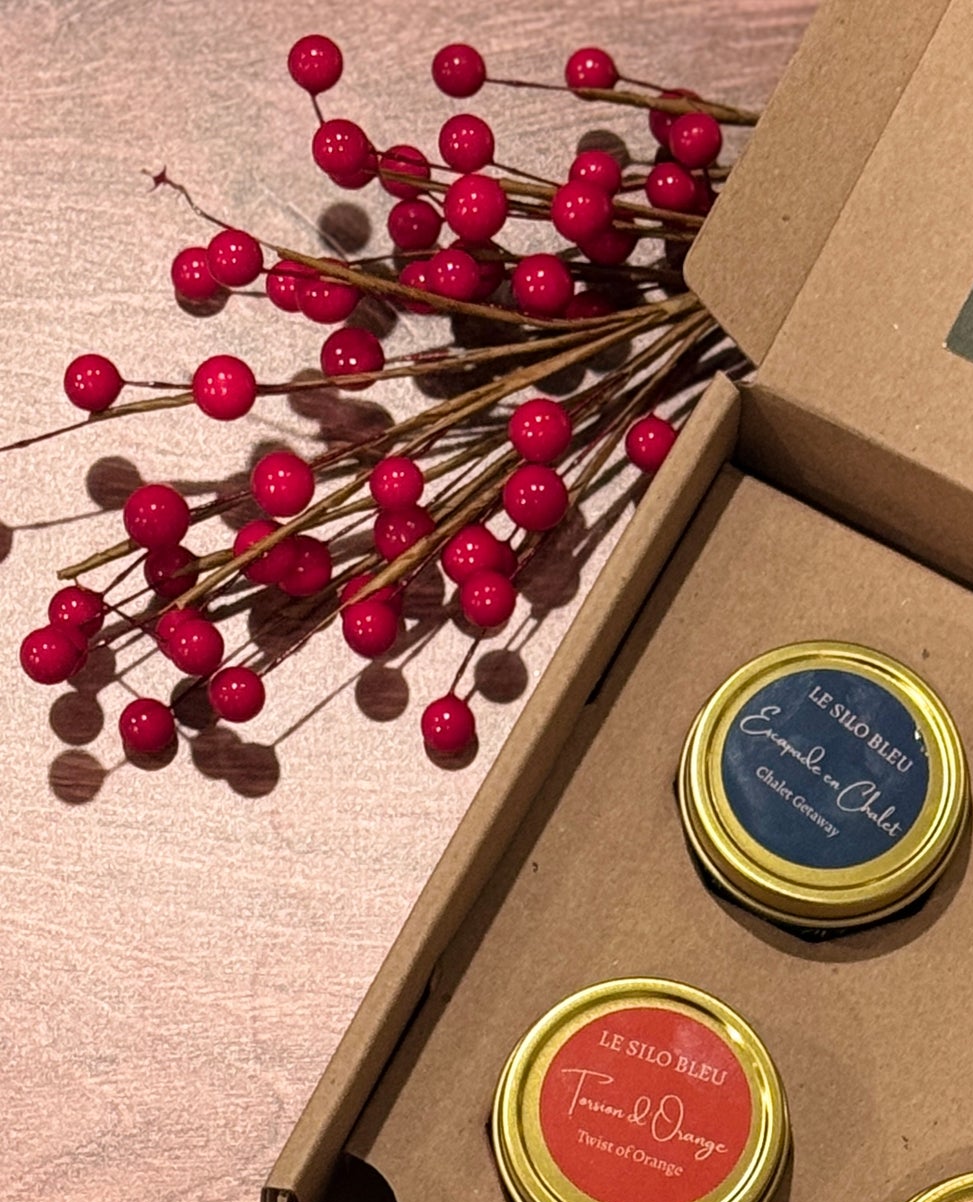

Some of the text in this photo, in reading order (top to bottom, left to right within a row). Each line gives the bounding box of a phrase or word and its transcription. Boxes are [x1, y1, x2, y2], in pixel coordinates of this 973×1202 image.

[807, 685, 913, 772] LE SILO BLEU
[738, 704, 900, 836] Escapade en Chalet
[755, 765, 839, 838] Chalet Getaway
[598, 1029, 727, 1085] LE SILO BLEU
[560, 1067, 625, 1118] Torsion
[577, 1128, 683, 1176] Twist of Orange
